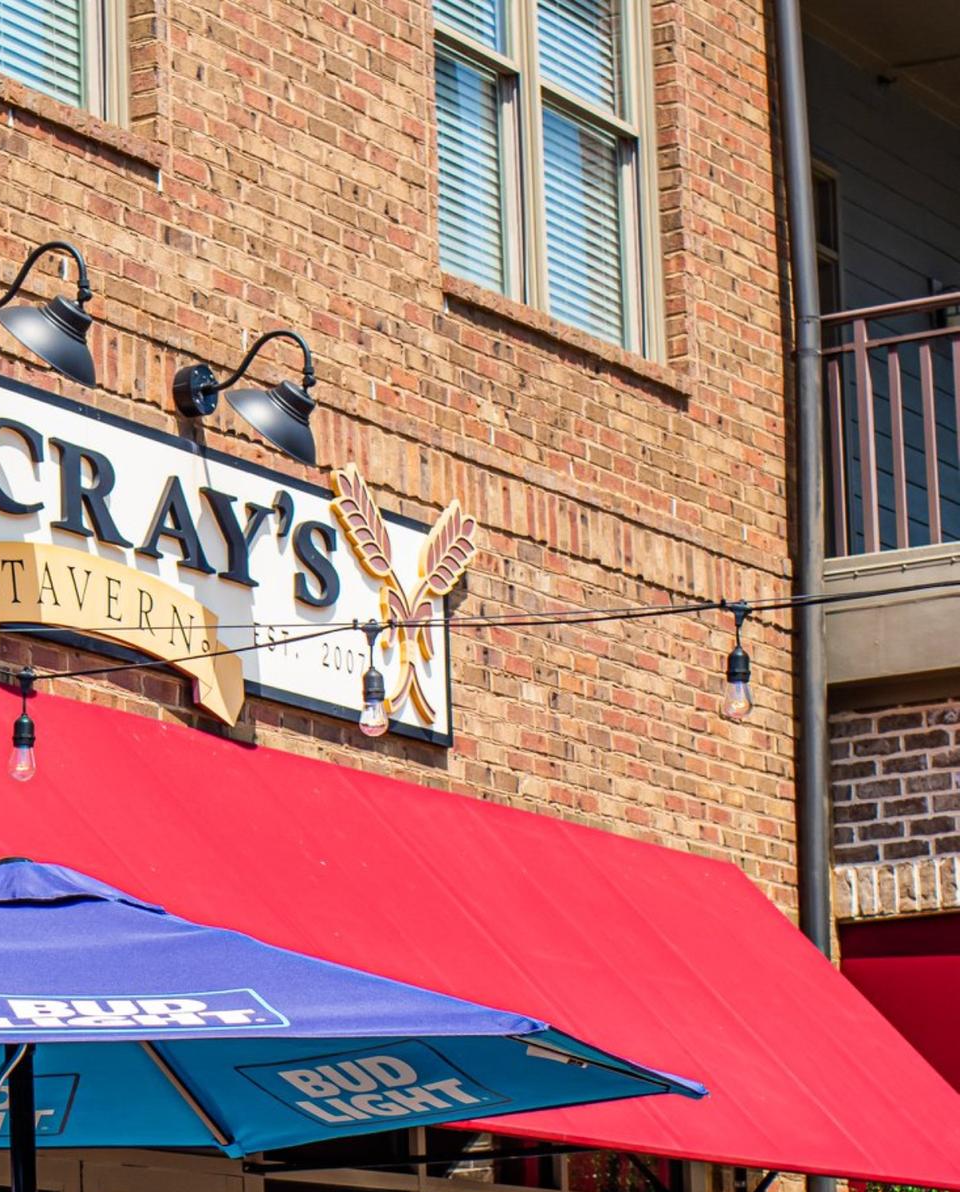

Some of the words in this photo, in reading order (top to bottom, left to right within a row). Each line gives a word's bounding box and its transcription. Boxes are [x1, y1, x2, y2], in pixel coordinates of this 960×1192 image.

[0, 559, 194, 654] TAVERN
[321, 642, 366, 675] 2007
[7, 998, 207, 1019] BUD
[278, 1055, 417, 1098] BUD
[295, 1078, 481, 1123] LIGHT
